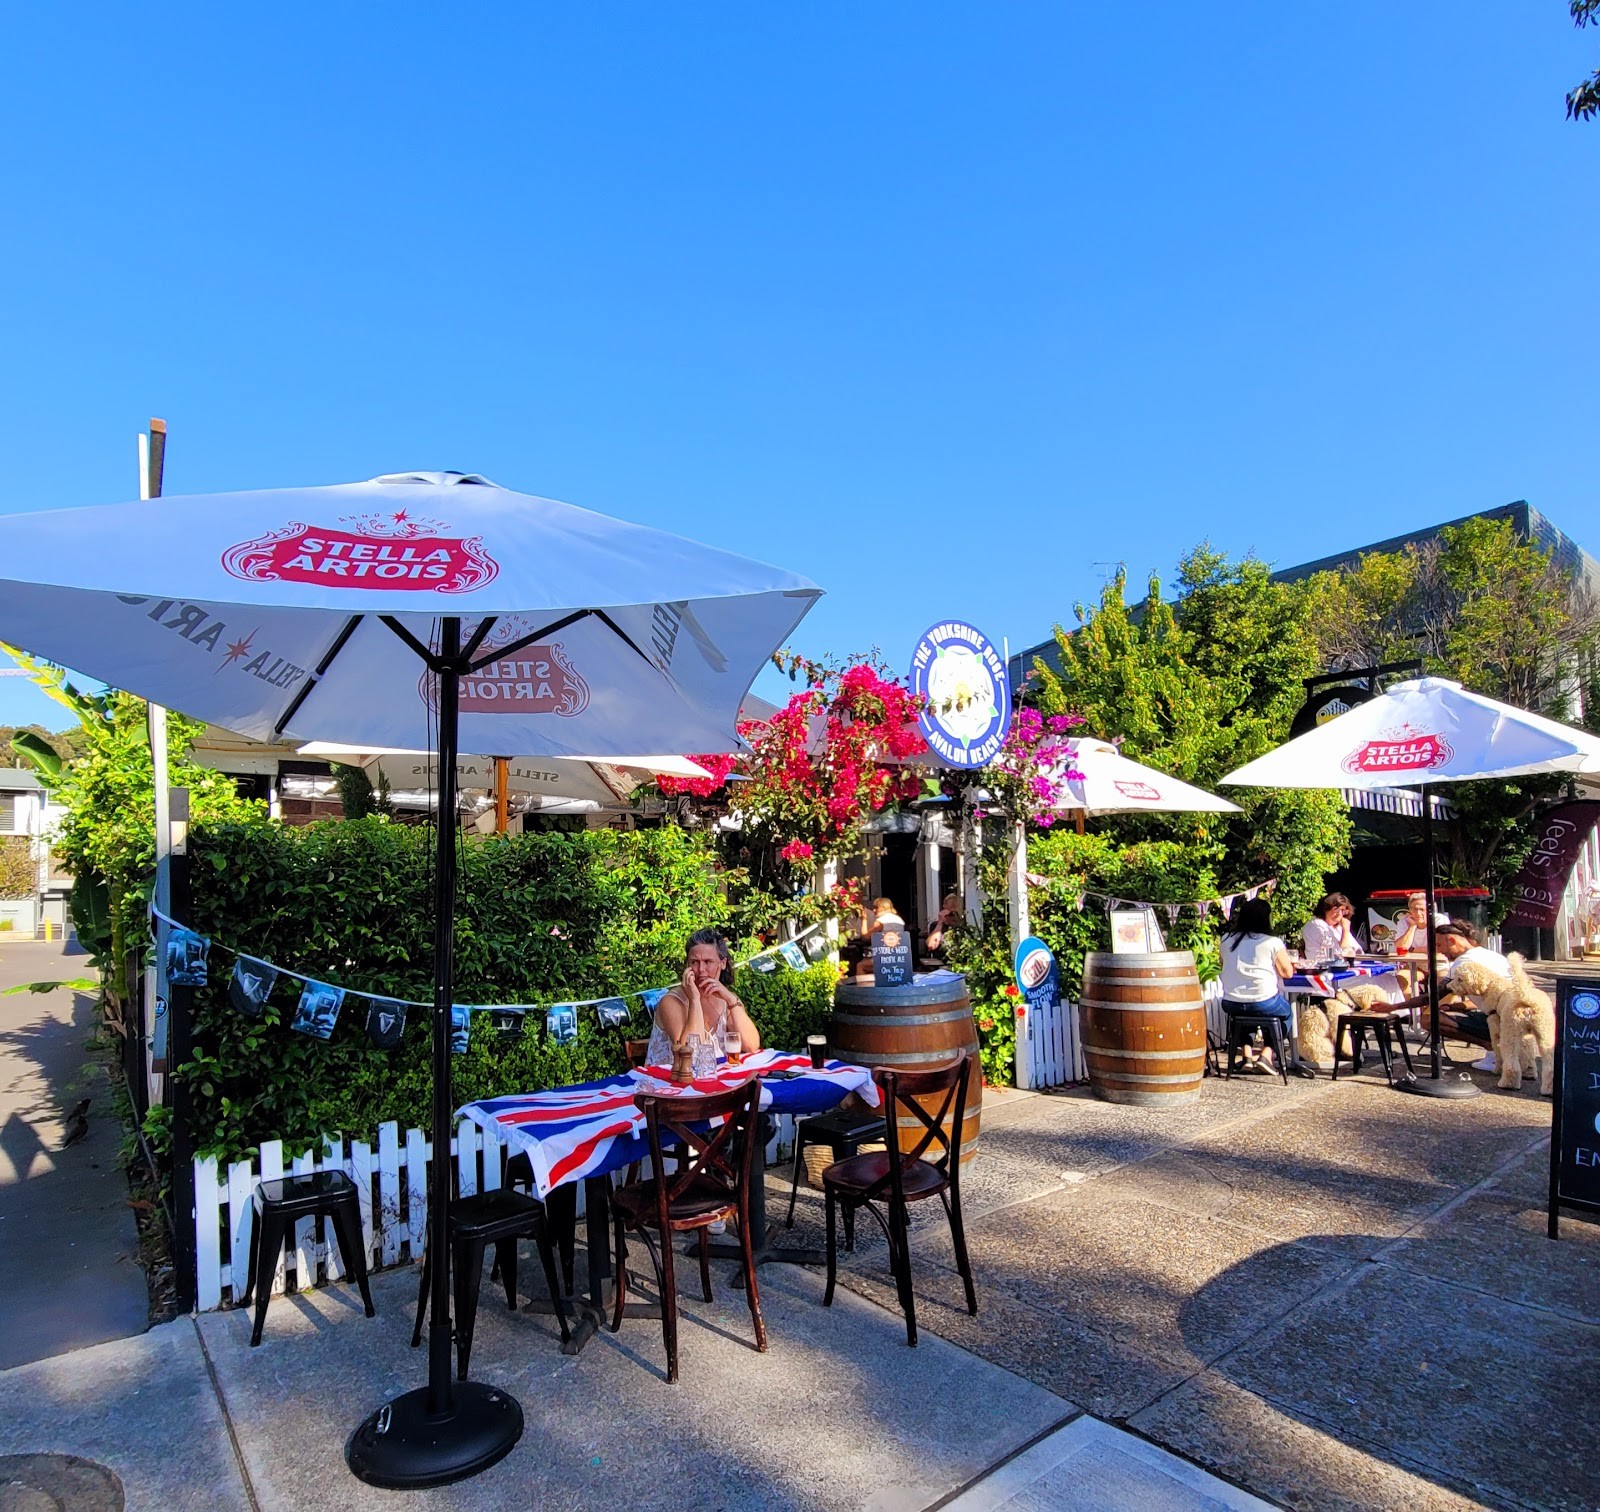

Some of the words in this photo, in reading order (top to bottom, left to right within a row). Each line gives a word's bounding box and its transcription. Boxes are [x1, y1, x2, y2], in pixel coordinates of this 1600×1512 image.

[298, 538, 452, 563] STELLA
[282, 555, 448, 579] ARTOIS
[913, 641, 932, 670] THE
[926, 623, 985, 650] YORKSHIRE
[928, 731, 968, 765] AVALON
[969, 733, 1001, 765] BEACH
[1363, 751, 1431, 766] ARTOIS
[1366, 741, 1433, 756] STELLA
[1026, 983, 1054, 999] SMOOTH
[1031, 992, 1054, 1010] FLOW
